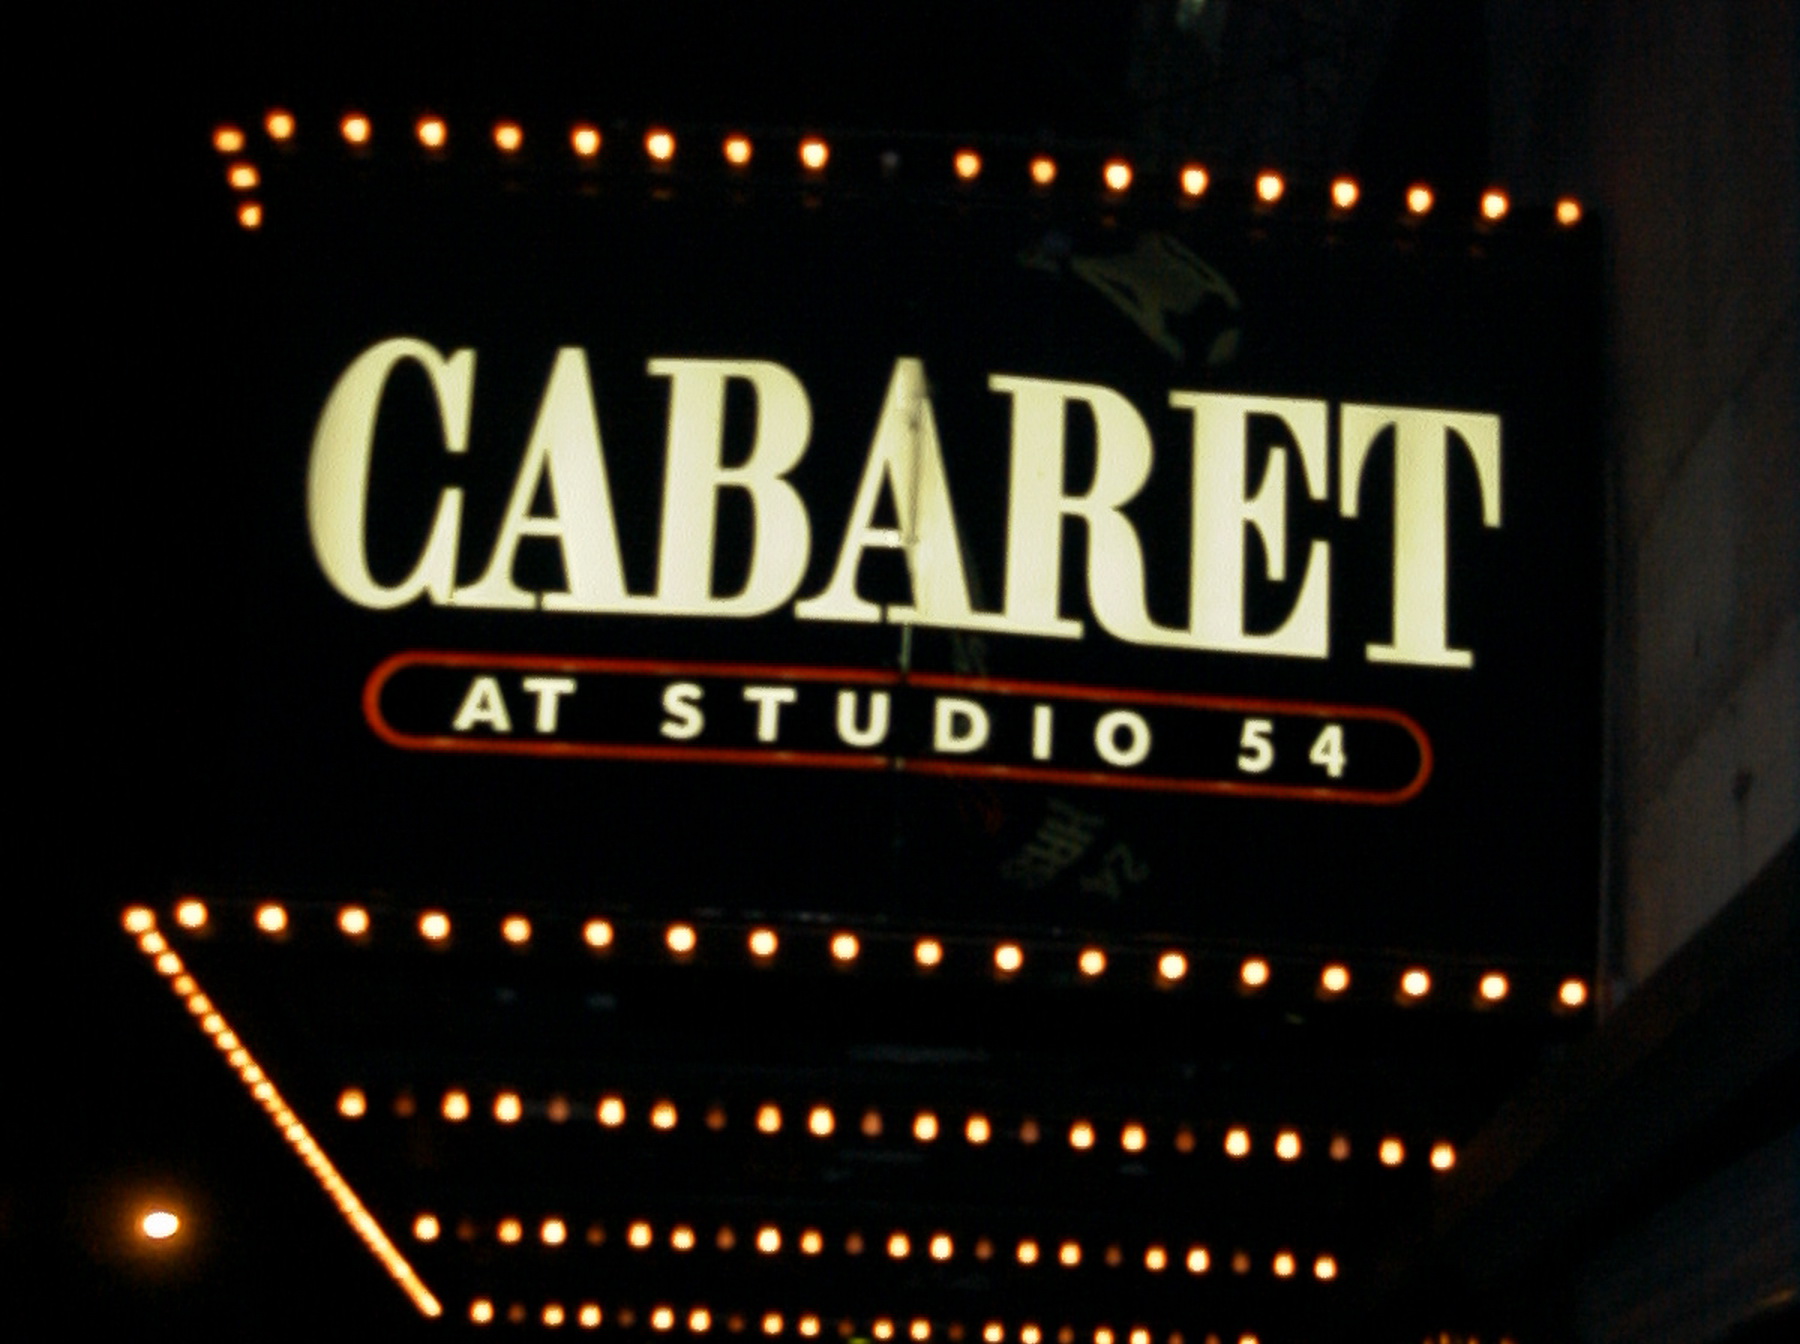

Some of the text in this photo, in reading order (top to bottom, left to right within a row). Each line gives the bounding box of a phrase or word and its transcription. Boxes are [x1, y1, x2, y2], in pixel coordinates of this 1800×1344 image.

[307, 336, 1502, 669] CABARET
[453, 676, 1348, 779] AT STUDIO 54
